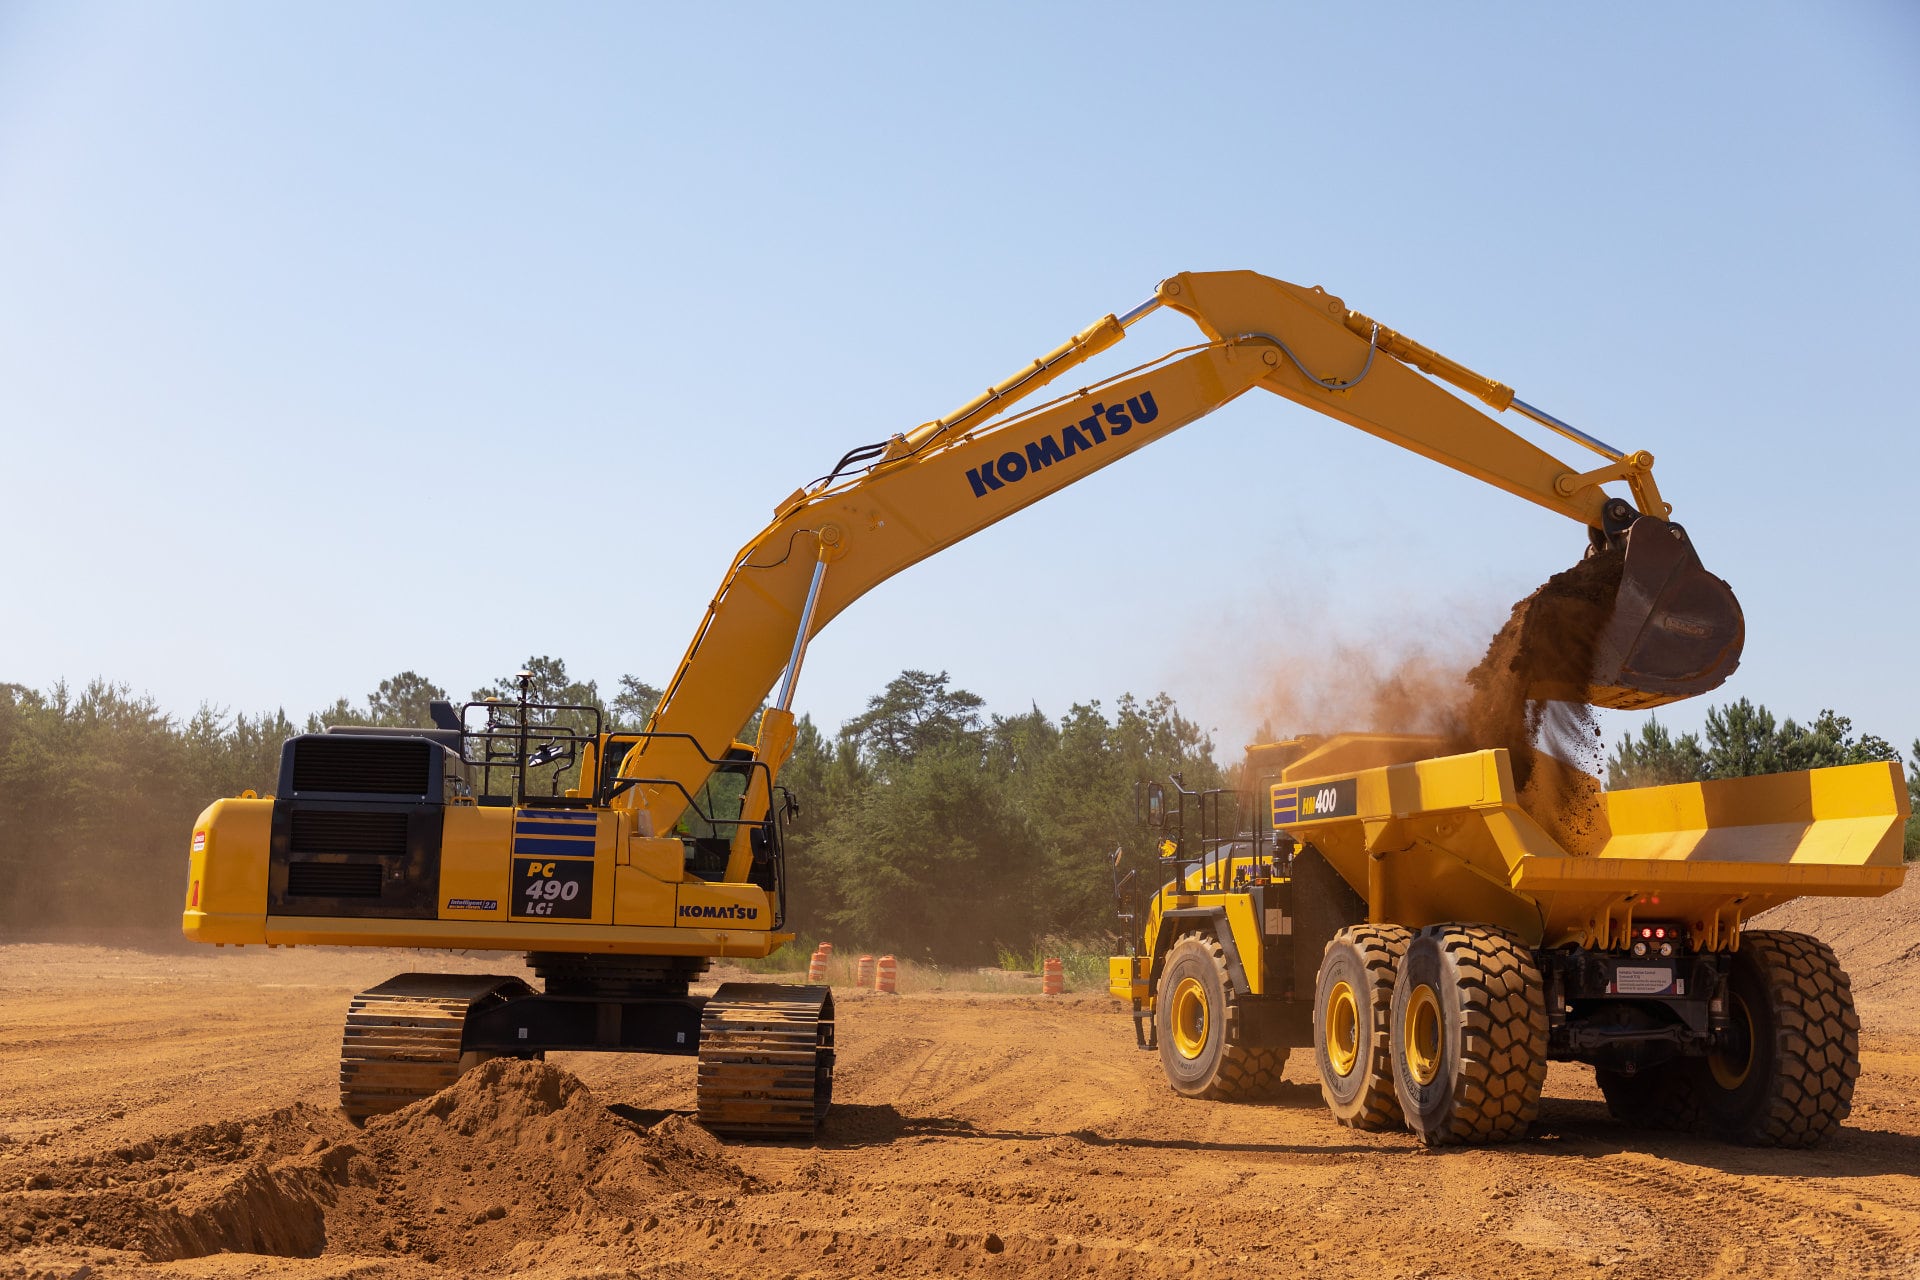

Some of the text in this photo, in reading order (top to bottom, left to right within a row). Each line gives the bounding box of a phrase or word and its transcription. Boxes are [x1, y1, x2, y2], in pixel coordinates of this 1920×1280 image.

[965, 390, 1159, 498] KOMATSU
[527, 862, 556, 878] PC
[525, 880, 579, 901] 490
[484, 901, 496, 909] 2.0
[525, 902, 554, 915] LCi
[679, 904, 758, 920] KOMATSU
